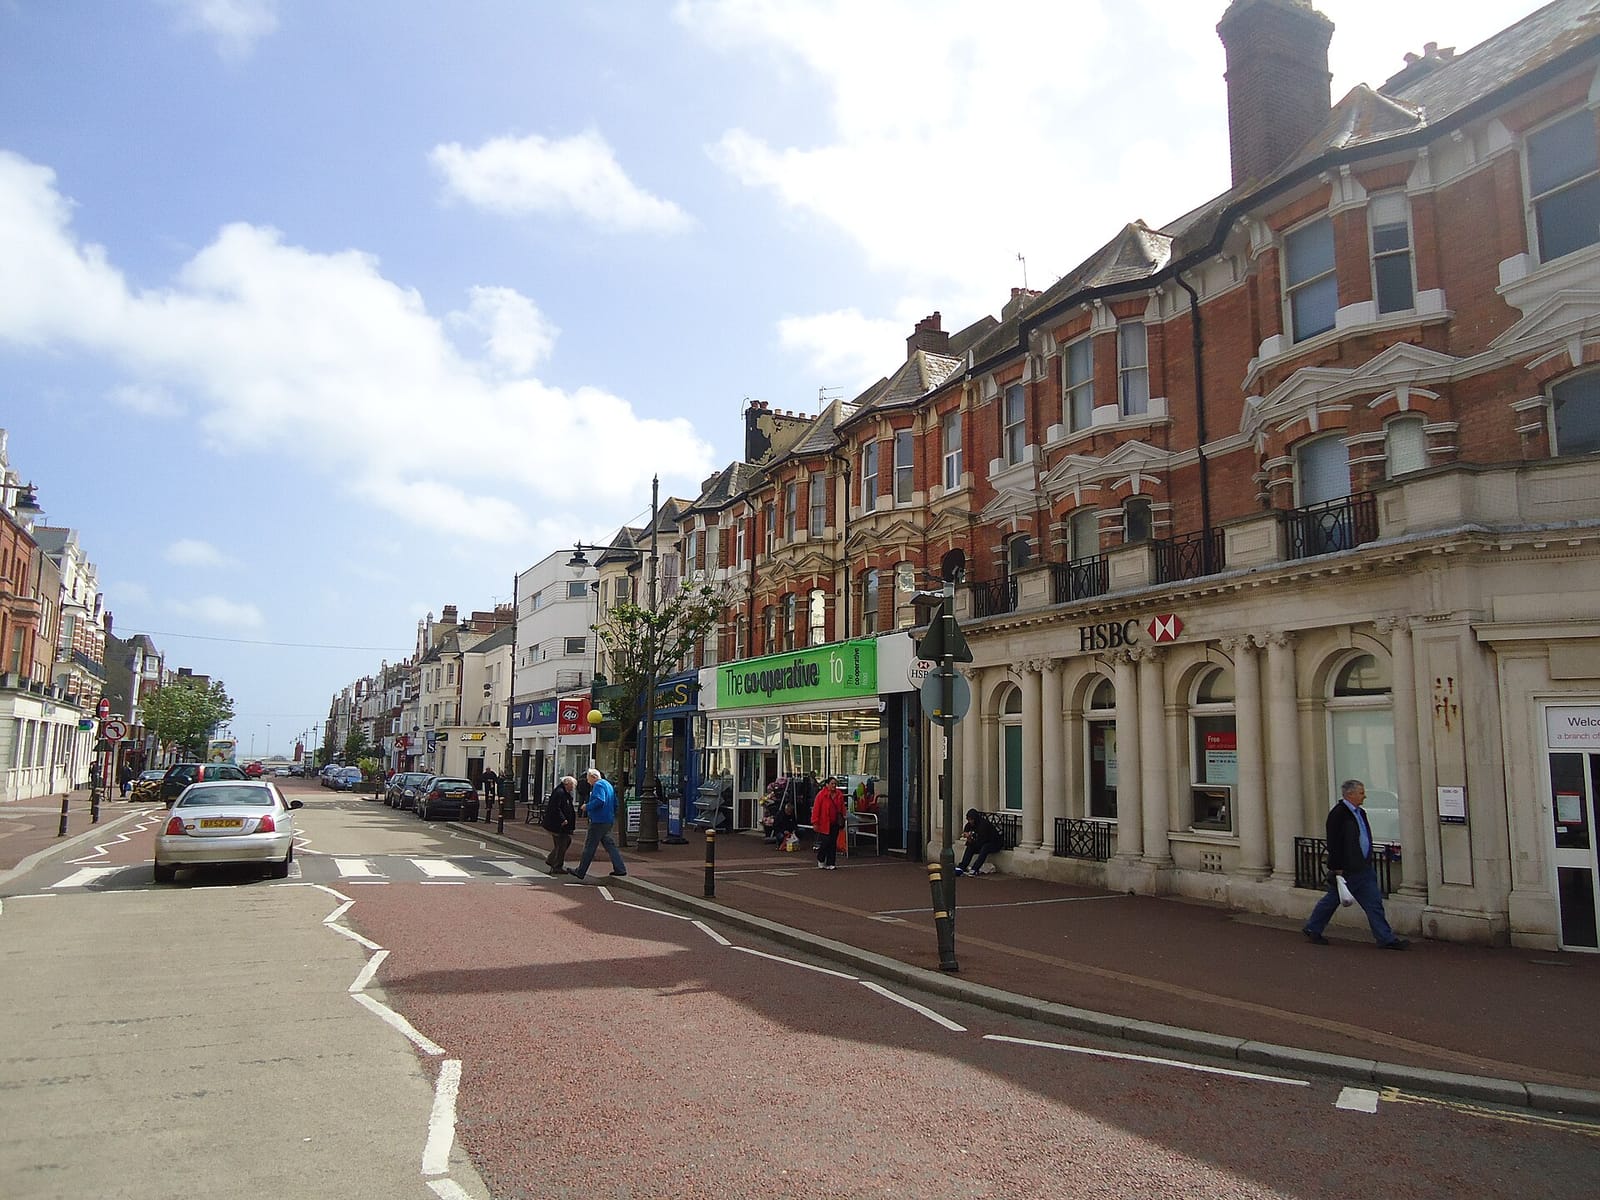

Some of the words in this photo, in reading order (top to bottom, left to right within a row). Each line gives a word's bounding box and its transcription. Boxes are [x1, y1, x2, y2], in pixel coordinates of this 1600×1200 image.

[1078, 619, 1139, 651] HSBC
[726, 669, 743, 696] The
[744, 659, 819, 698] co-operative
[829, 651, 843, 684] fo
[911, 669, 929, 678] HSB
